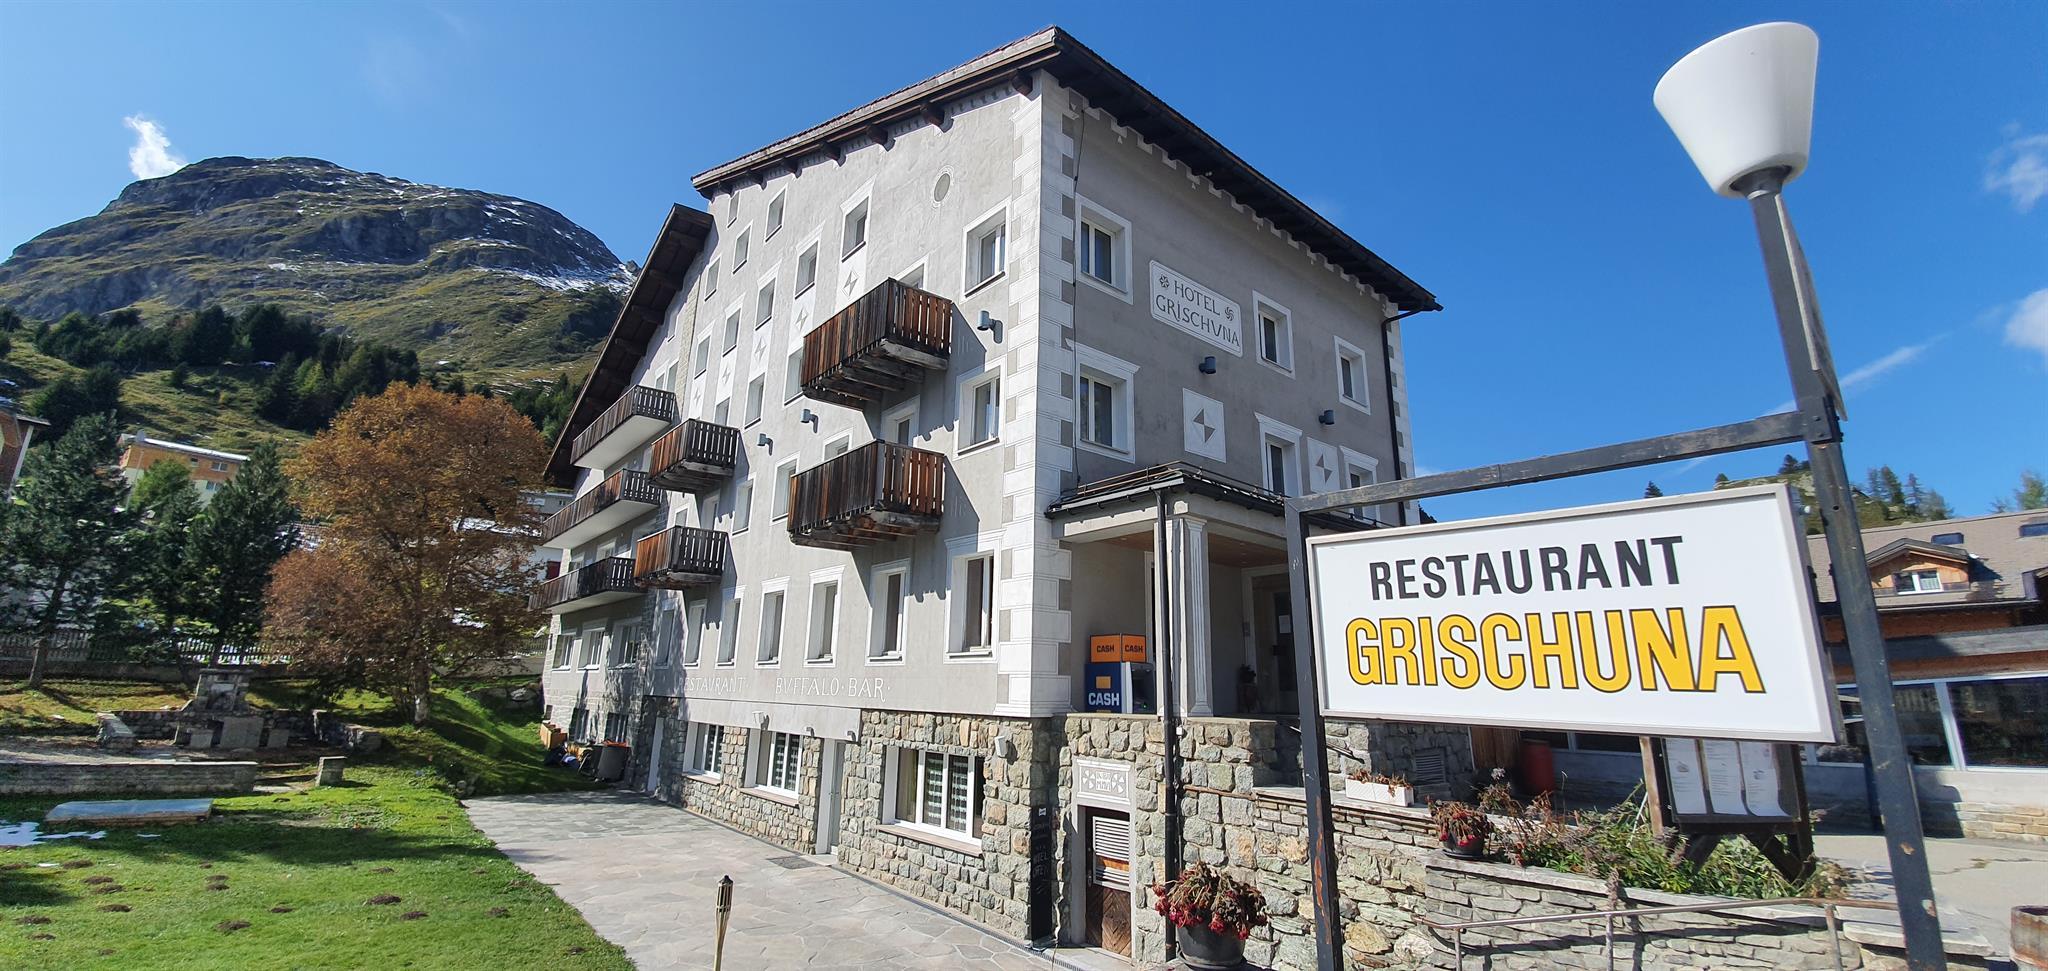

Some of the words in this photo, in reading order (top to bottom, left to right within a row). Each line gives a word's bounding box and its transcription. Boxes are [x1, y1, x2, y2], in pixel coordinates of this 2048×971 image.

[1174, 280, 1220, 316] HOTEL
[1370, 535, 1684, 600] RESTAURANT
[1096, 644, 1115, 653] CASH
[1124, 644, 1144, 653] CASH
[1345, 604, 1767, 694] GRISCHUNA
[848, 677, 886, 702] BAR
[1088, 692, 1120, 706] CASH
